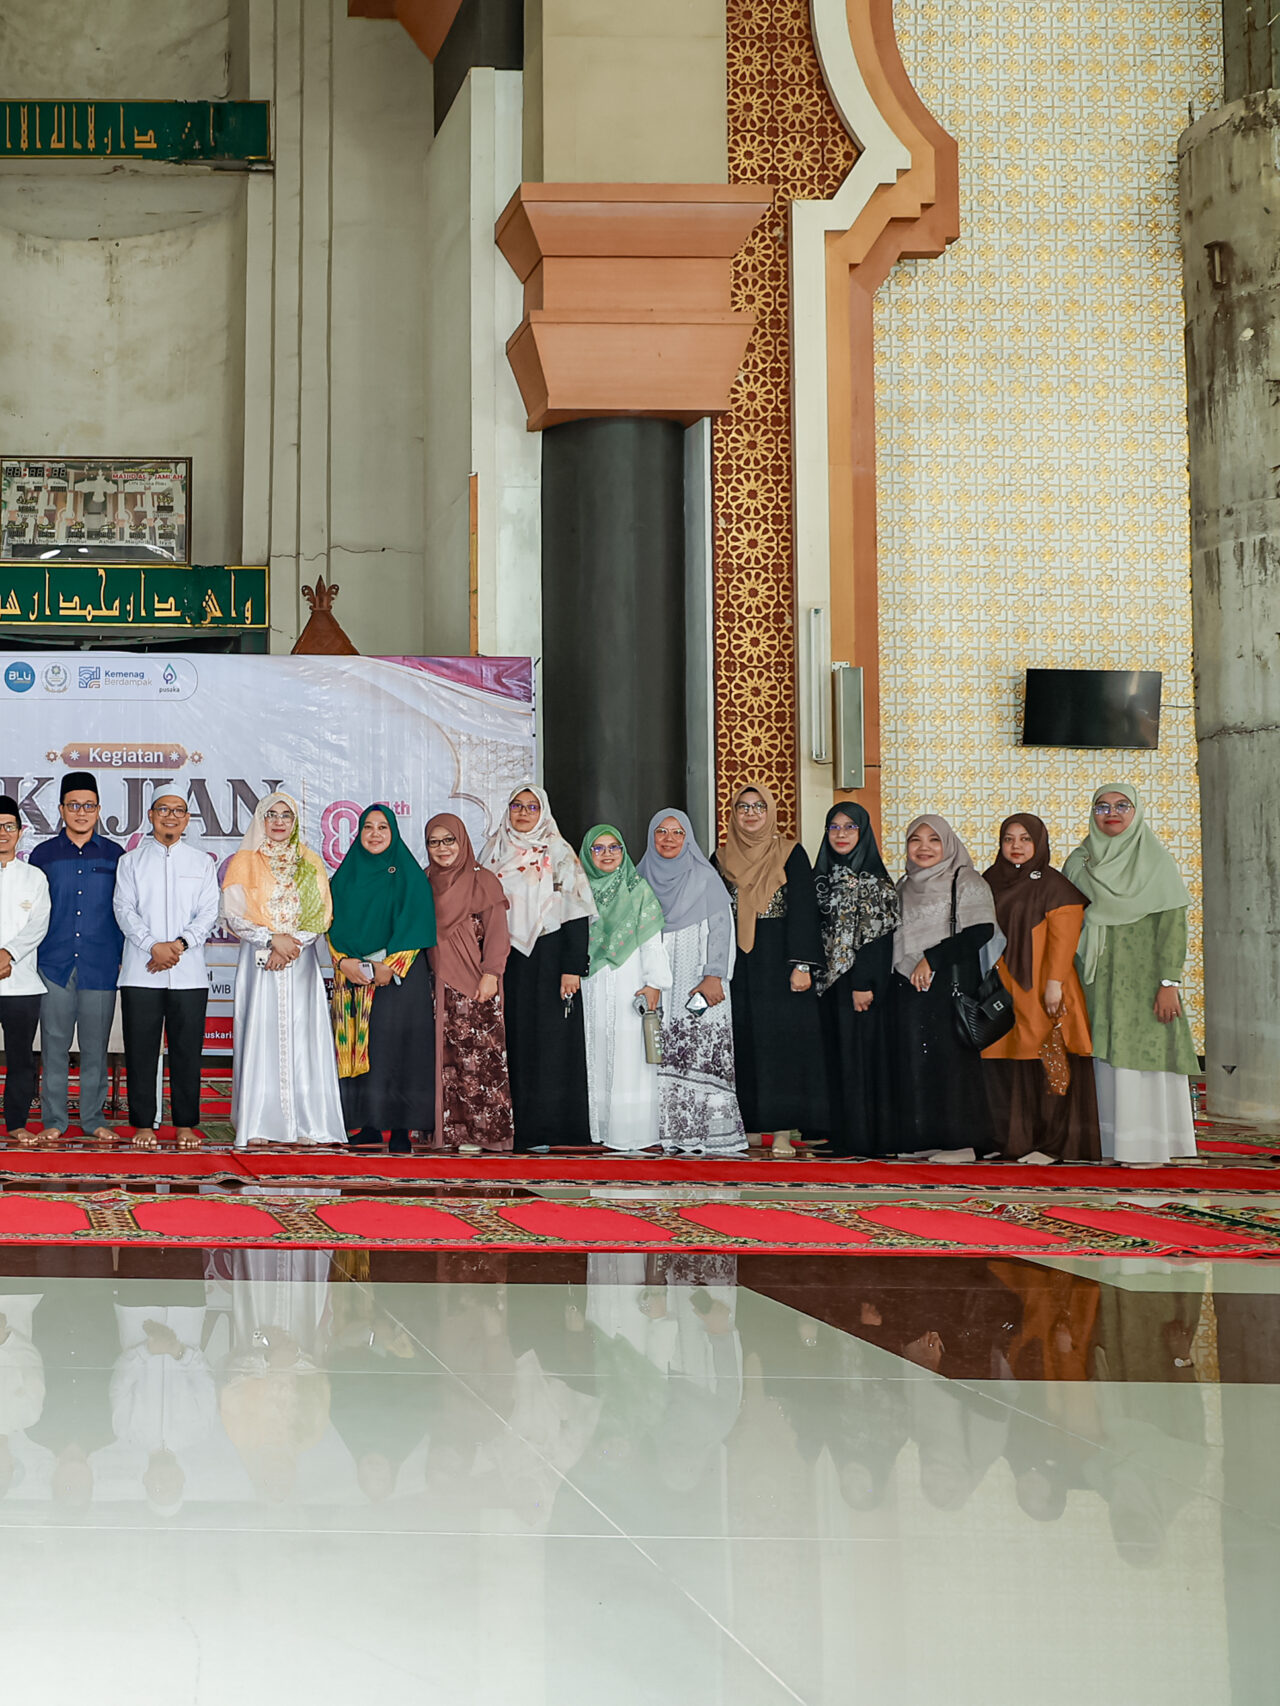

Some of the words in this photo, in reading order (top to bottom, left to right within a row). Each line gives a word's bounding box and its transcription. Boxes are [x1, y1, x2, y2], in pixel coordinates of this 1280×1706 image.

[8, 670, 32, 681] BLU
[104, 670, 145, 679] Kemenag
[104, 678, 153, 686] Berdampak
[89, 746, 164, 766] Kegiatan
[0, 776, 285, 838] KJAN
[211, 984, 231, 994] WIB
